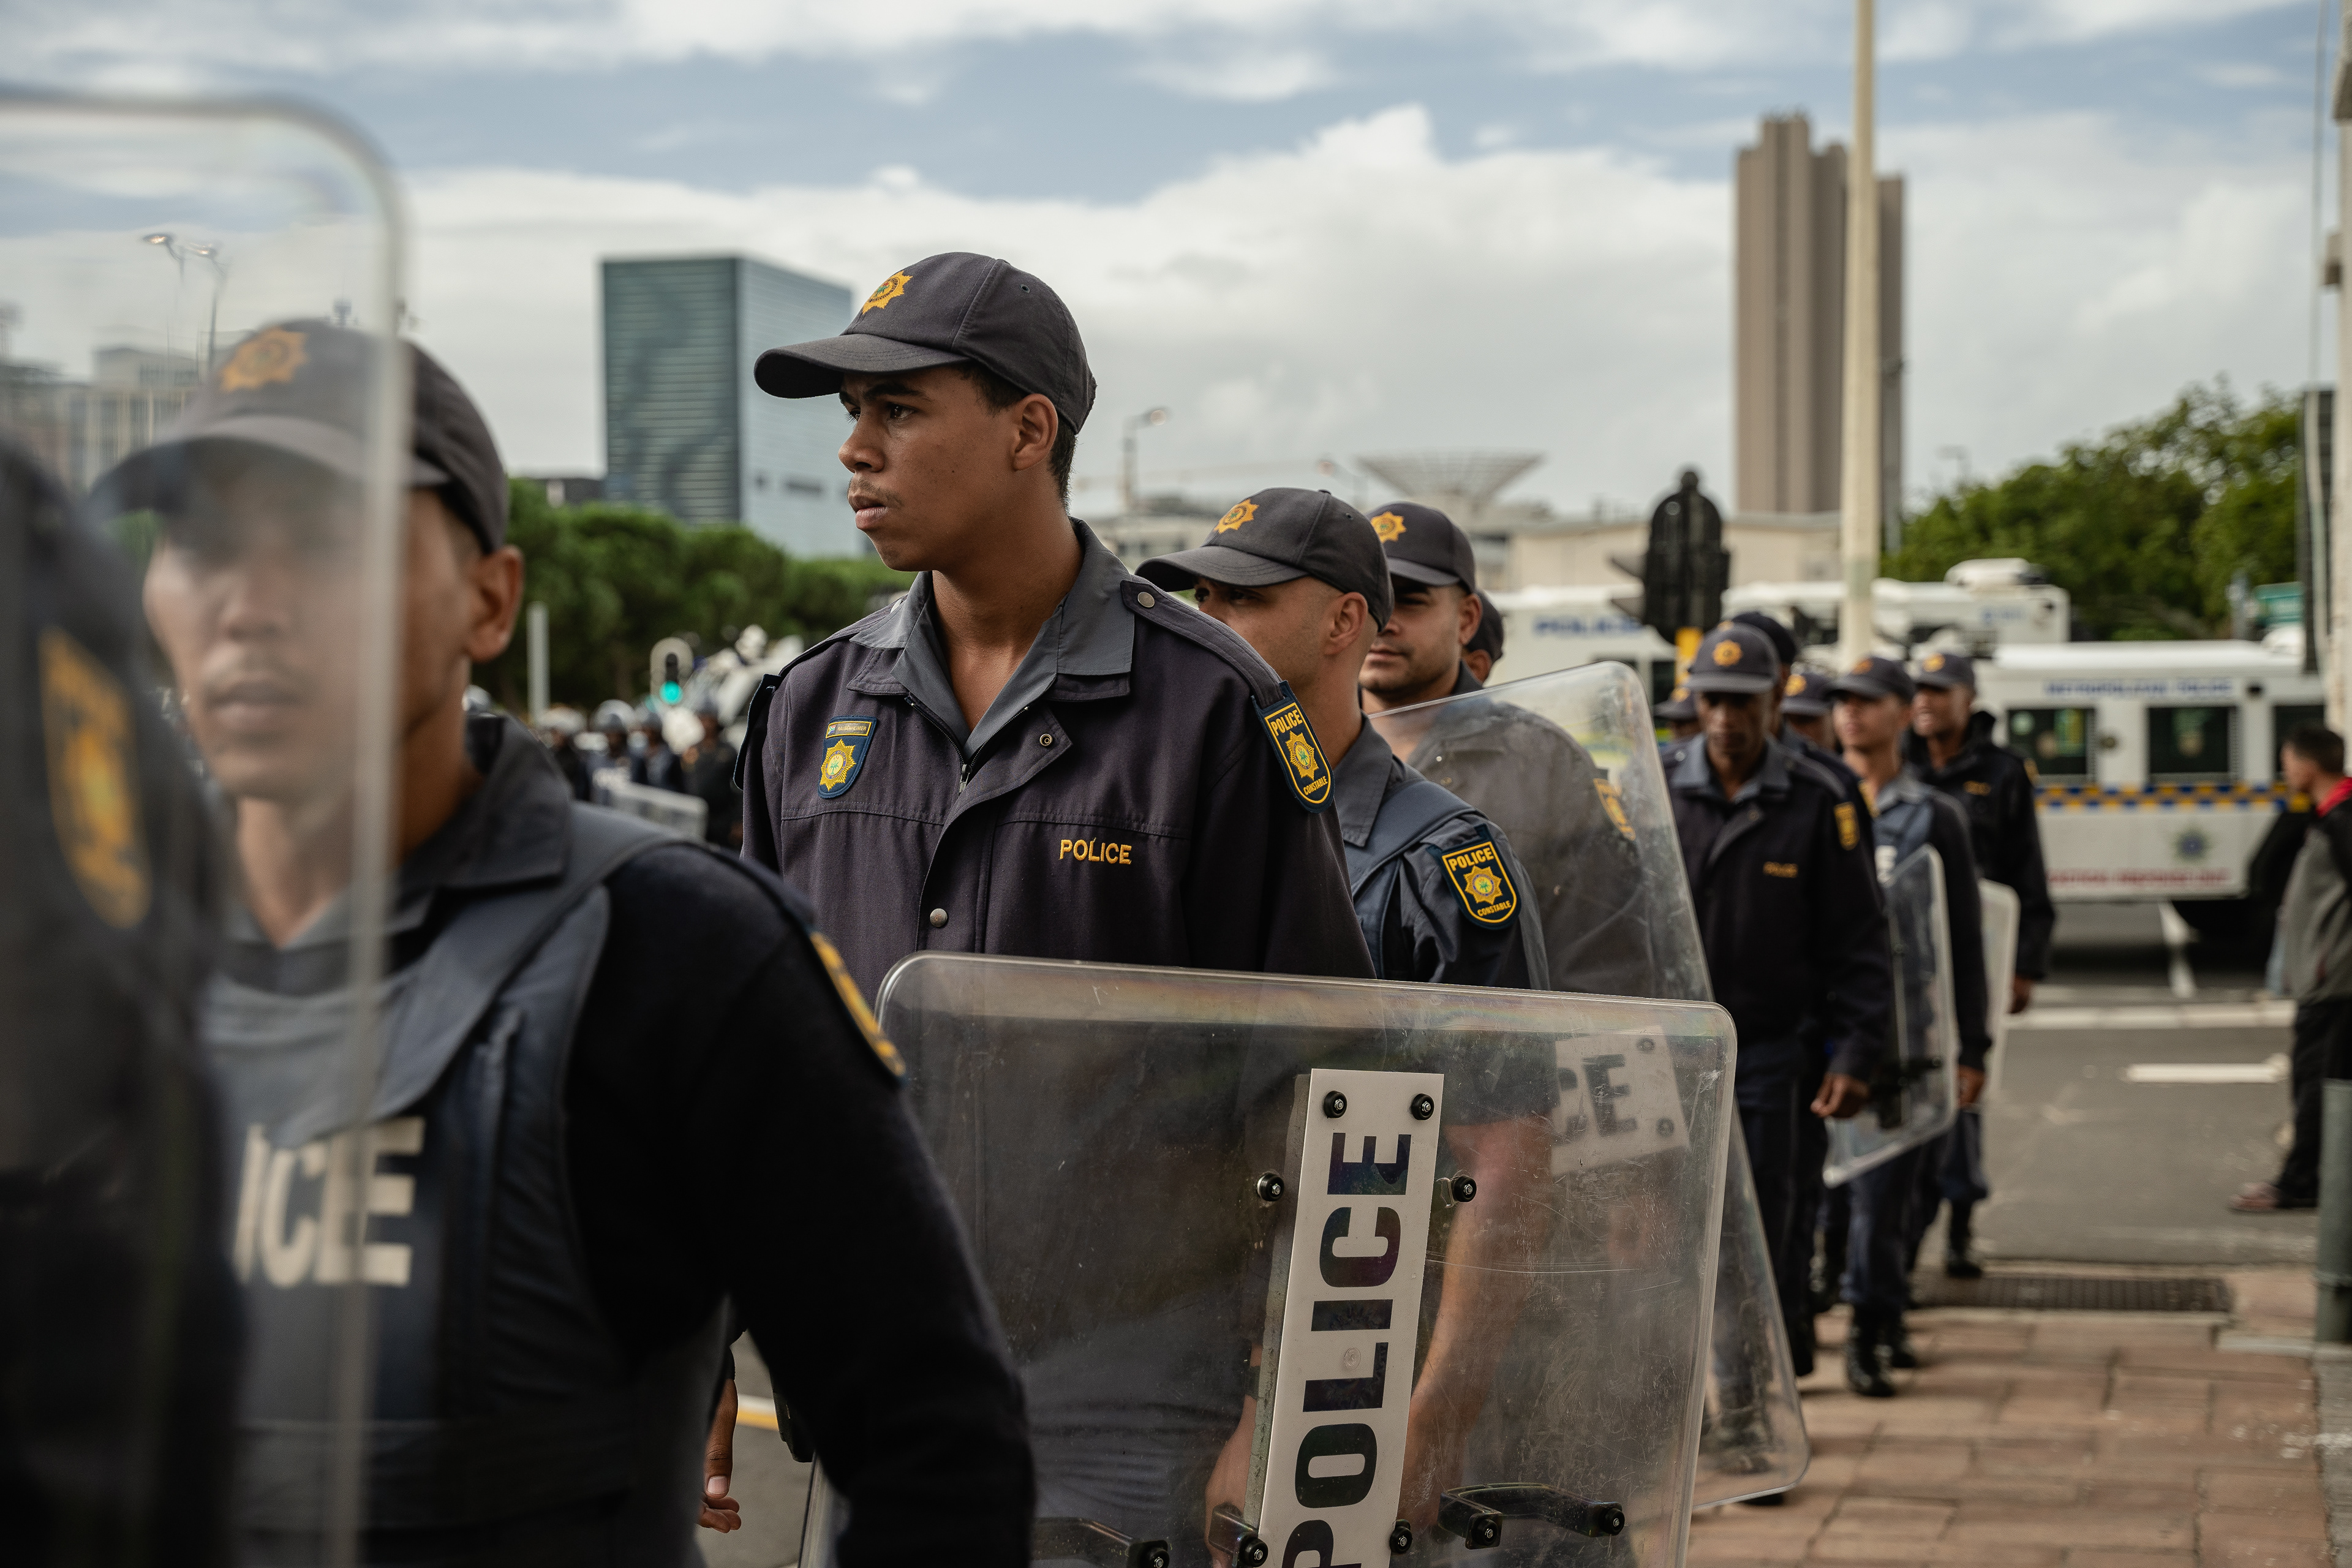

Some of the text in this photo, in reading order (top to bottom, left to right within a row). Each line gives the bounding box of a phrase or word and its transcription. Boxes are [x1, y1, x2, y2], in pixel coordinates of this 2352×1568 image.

[1270, 709, 1303, 736] POLICE
[1303, 775, 1328, 796] CONSTABLE
[1059, 839, 1133, 865] POLICE
[1448, 847, 1494, 872] POLICE
[1477, 900, 1512, 917] CONSTABLE
[1281, 1133, 1412, 1568] POLICE
